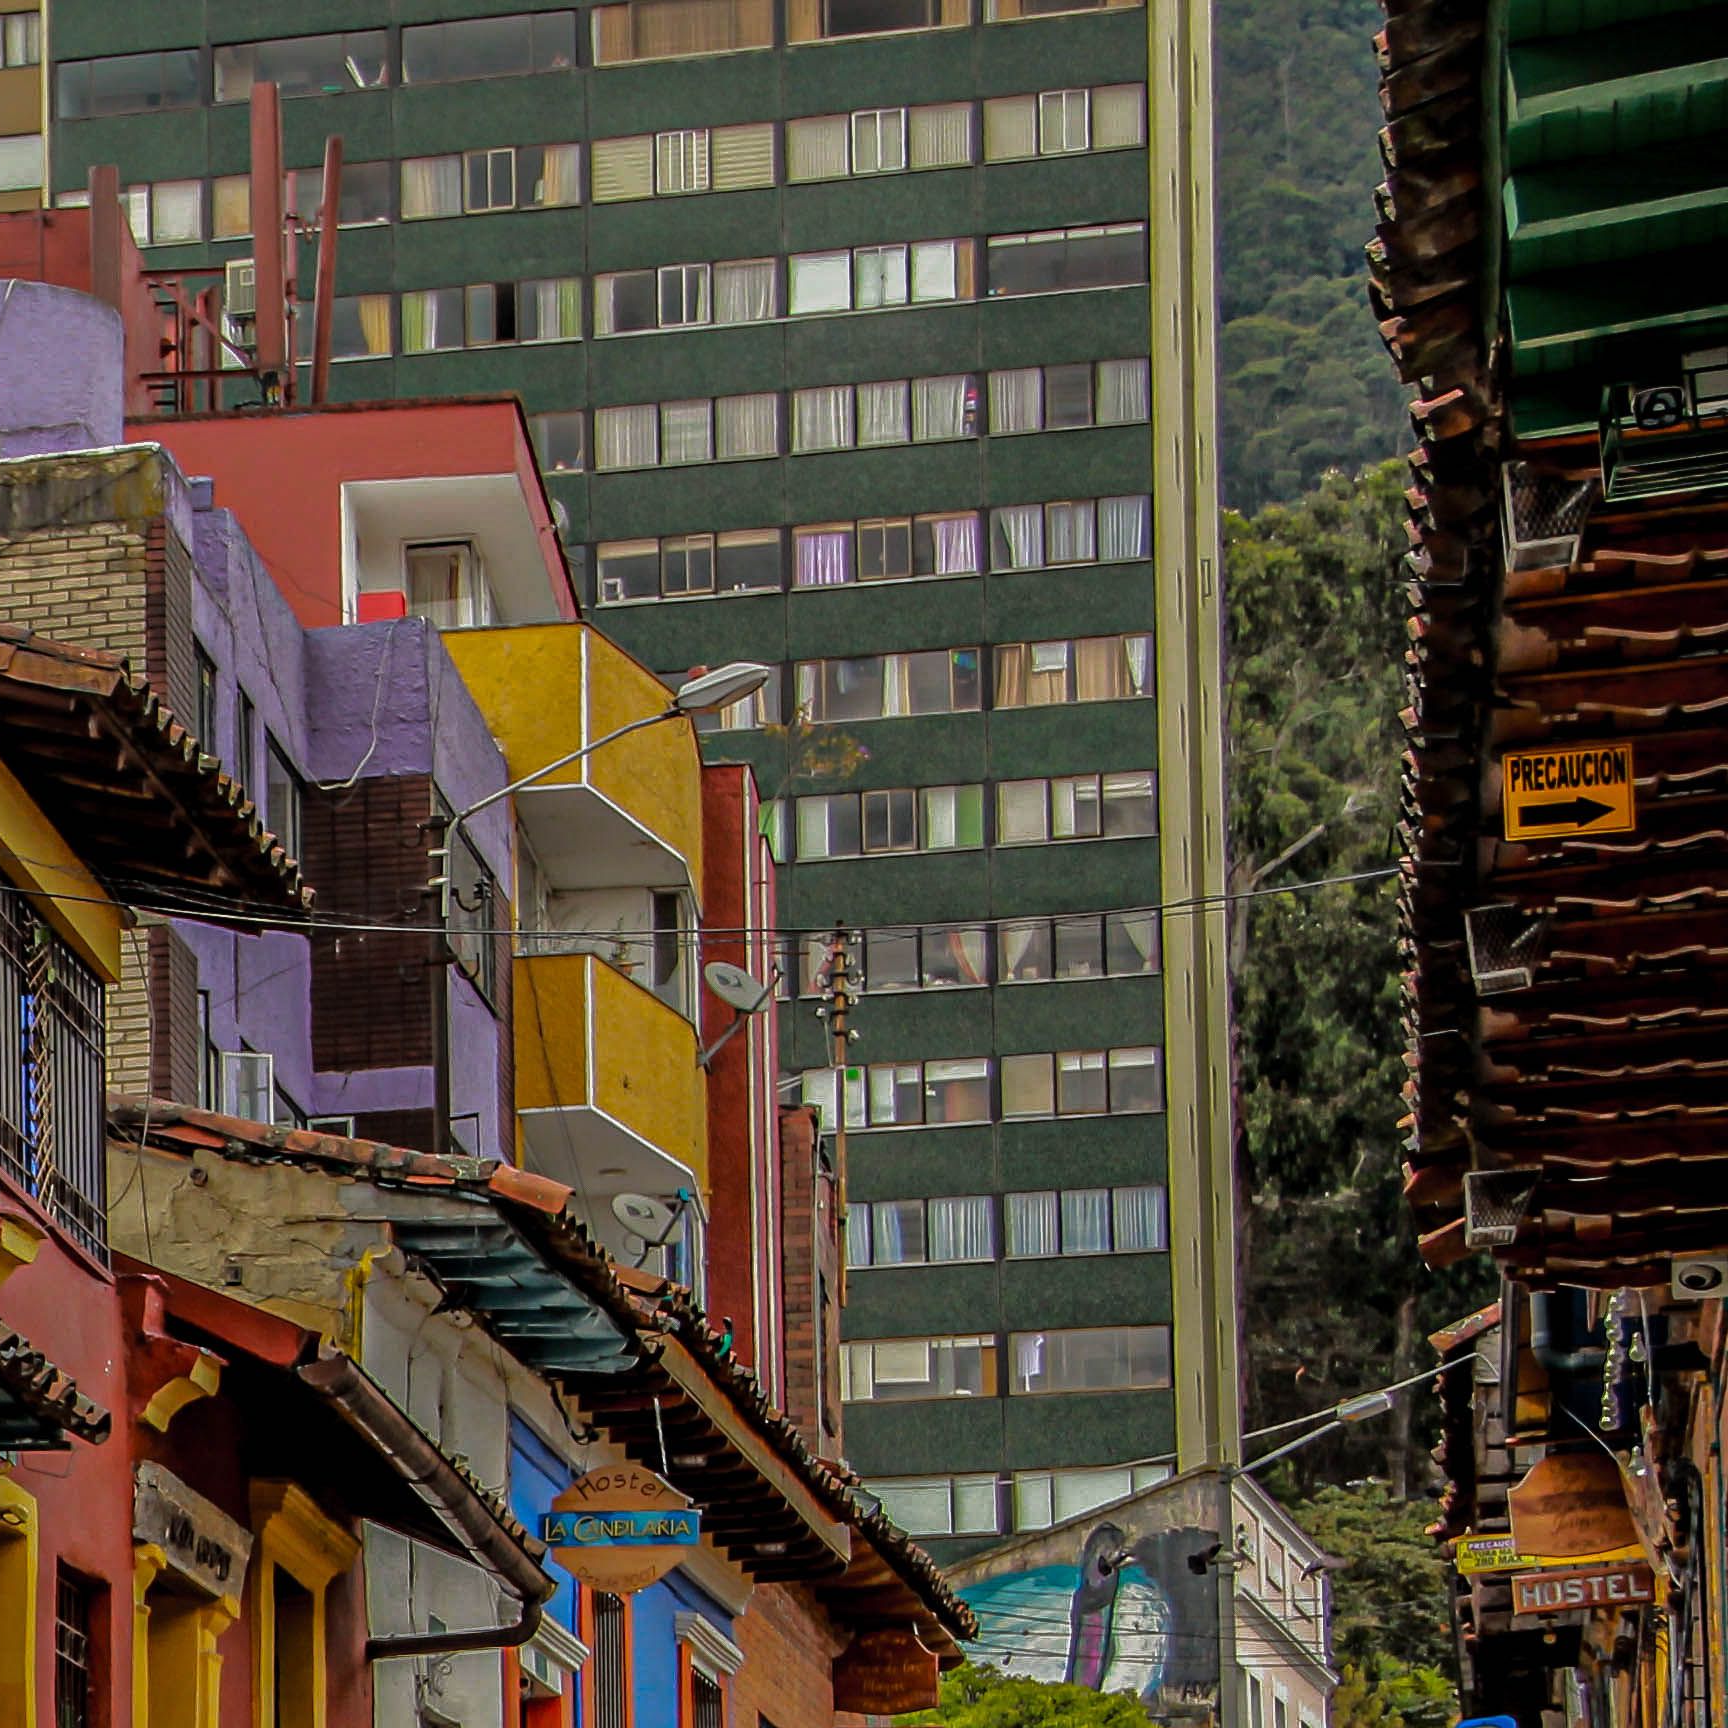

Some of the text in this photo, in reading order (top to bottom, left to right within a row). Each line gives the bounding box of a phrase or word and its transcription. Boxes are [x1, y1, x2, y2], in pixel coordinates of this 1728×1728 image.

[1510, 751, 1626, 793] PRECAUCION
[575, 1471, 667, 1501] Hostel
[1518, 1573, 1649, 1608] HOSTEL
